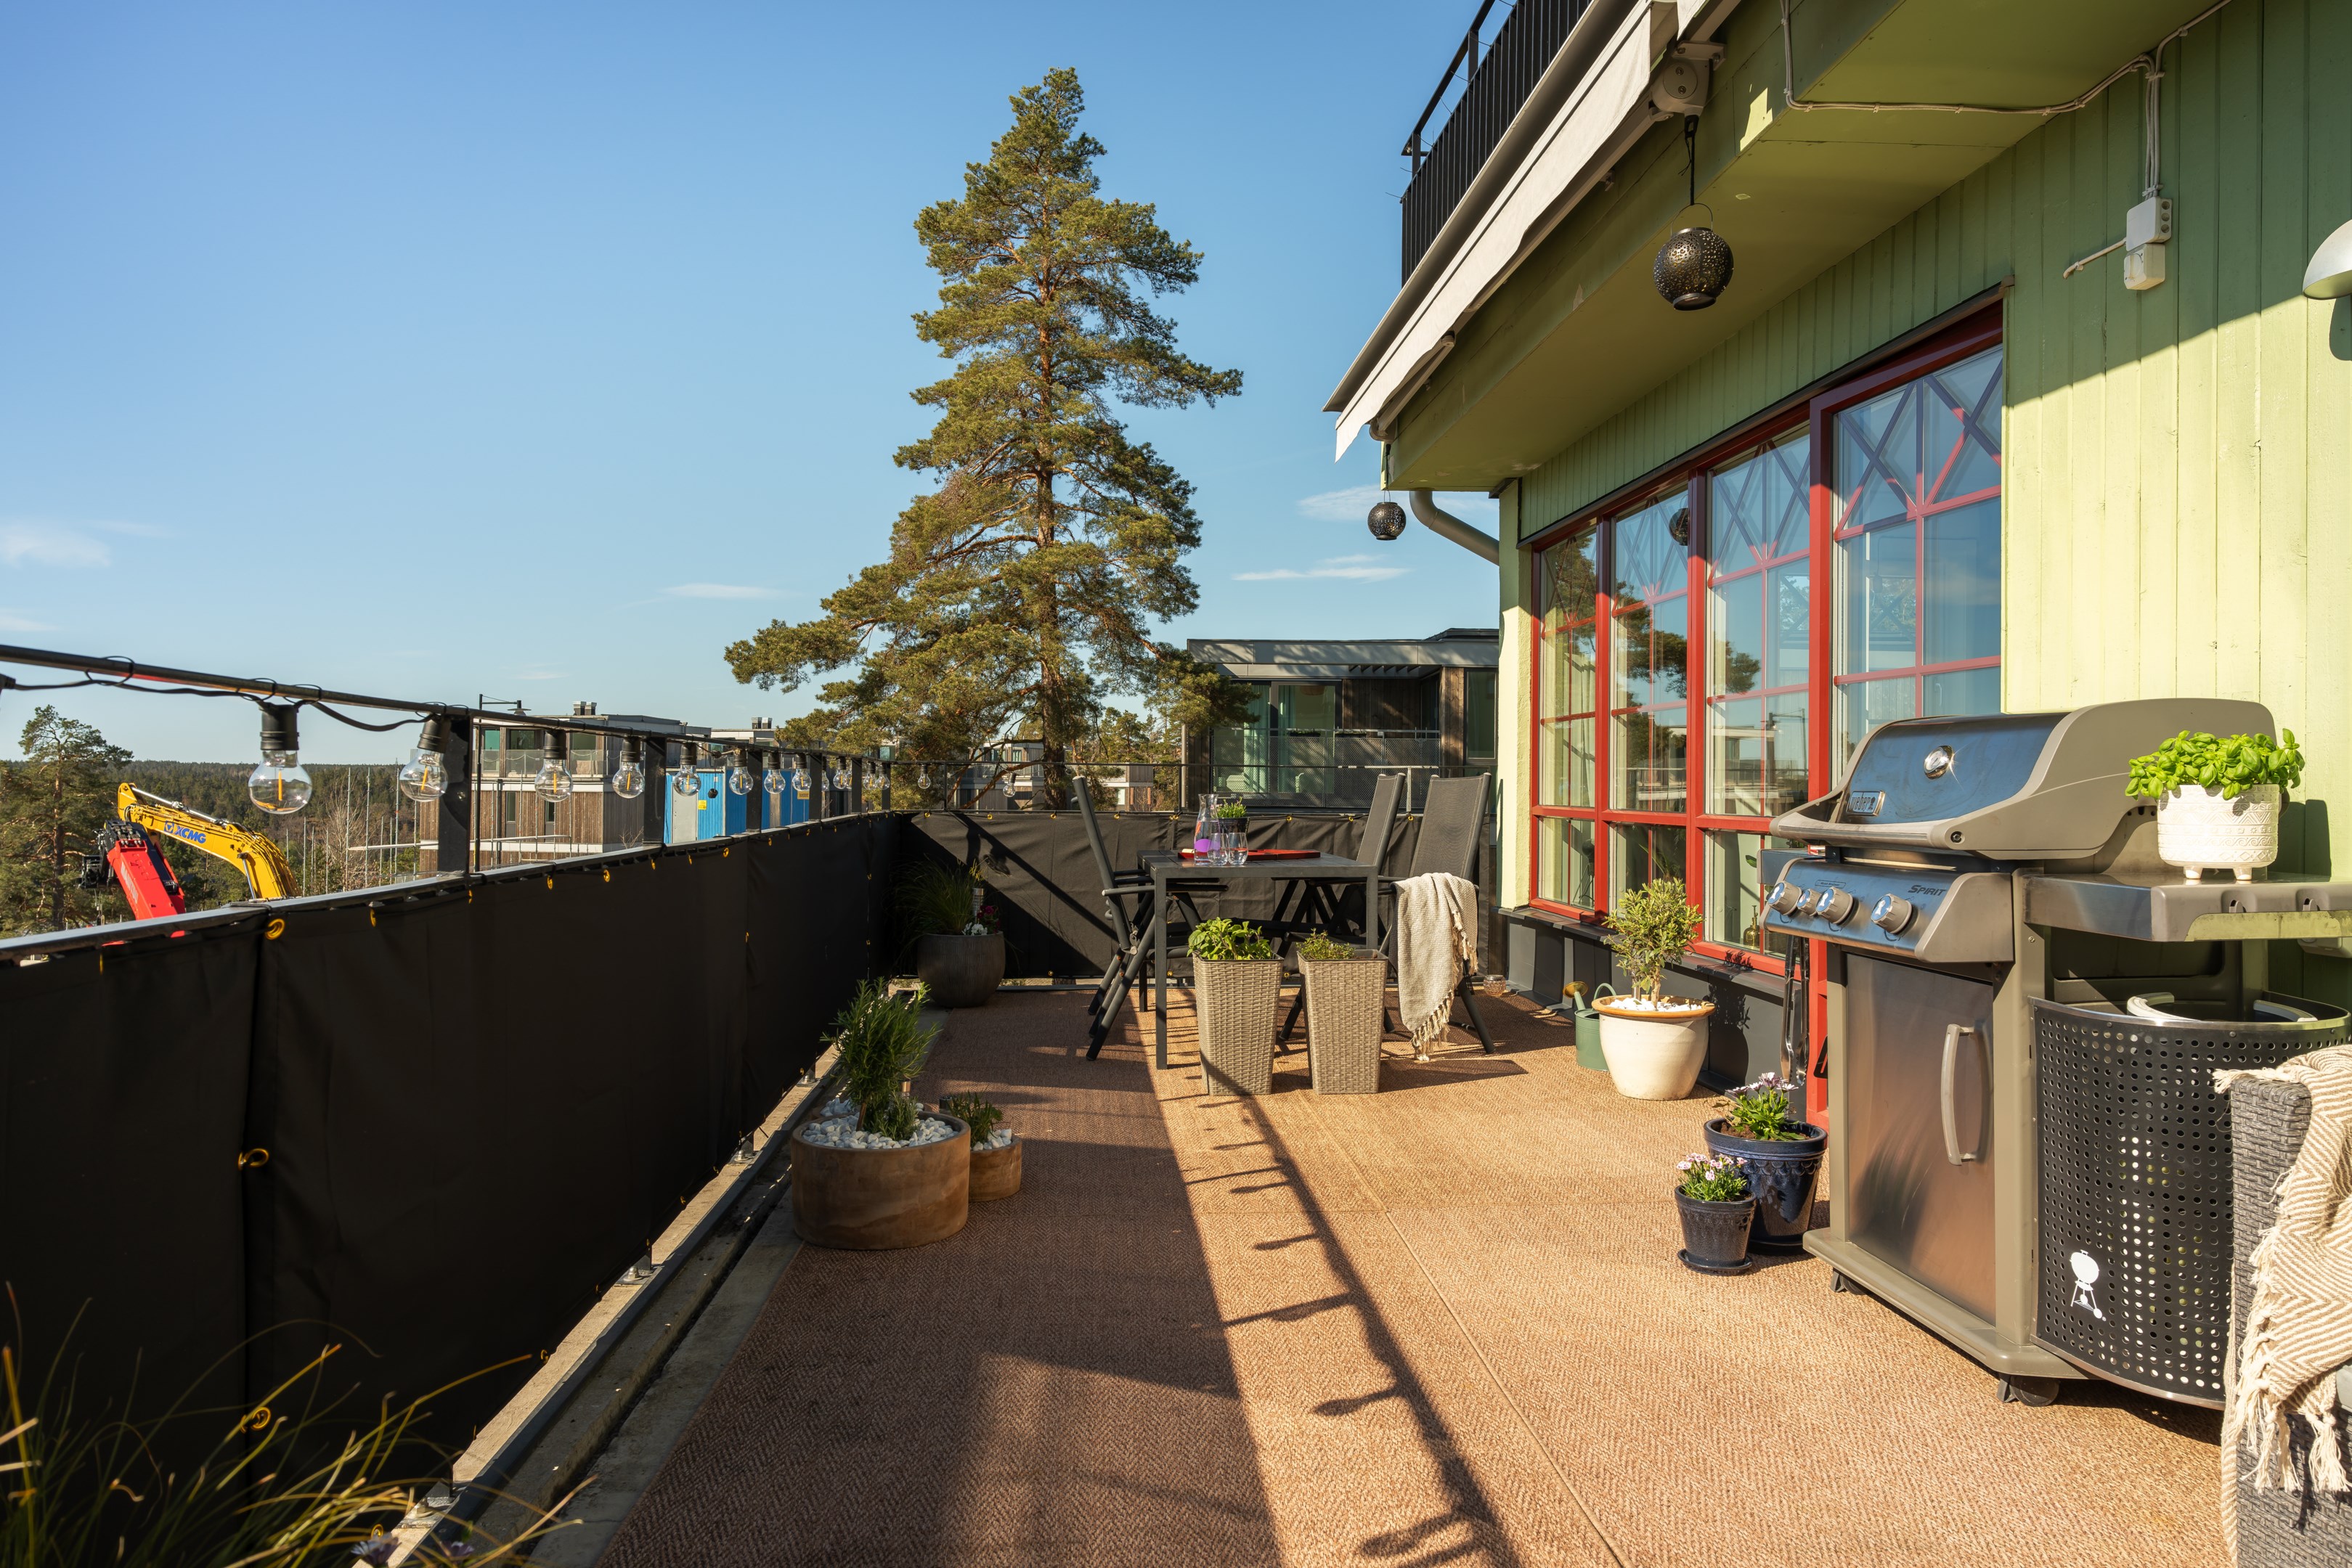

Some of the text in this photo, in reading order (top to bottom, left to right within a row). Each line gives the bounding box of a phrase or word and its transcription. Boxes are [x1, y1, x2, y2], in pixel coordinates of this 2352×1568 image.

[1848, 791, 1871, 810] weber
[174, 825, 206, 844] XCMG
[1908, 884, 1946, 897] SPIRIT
